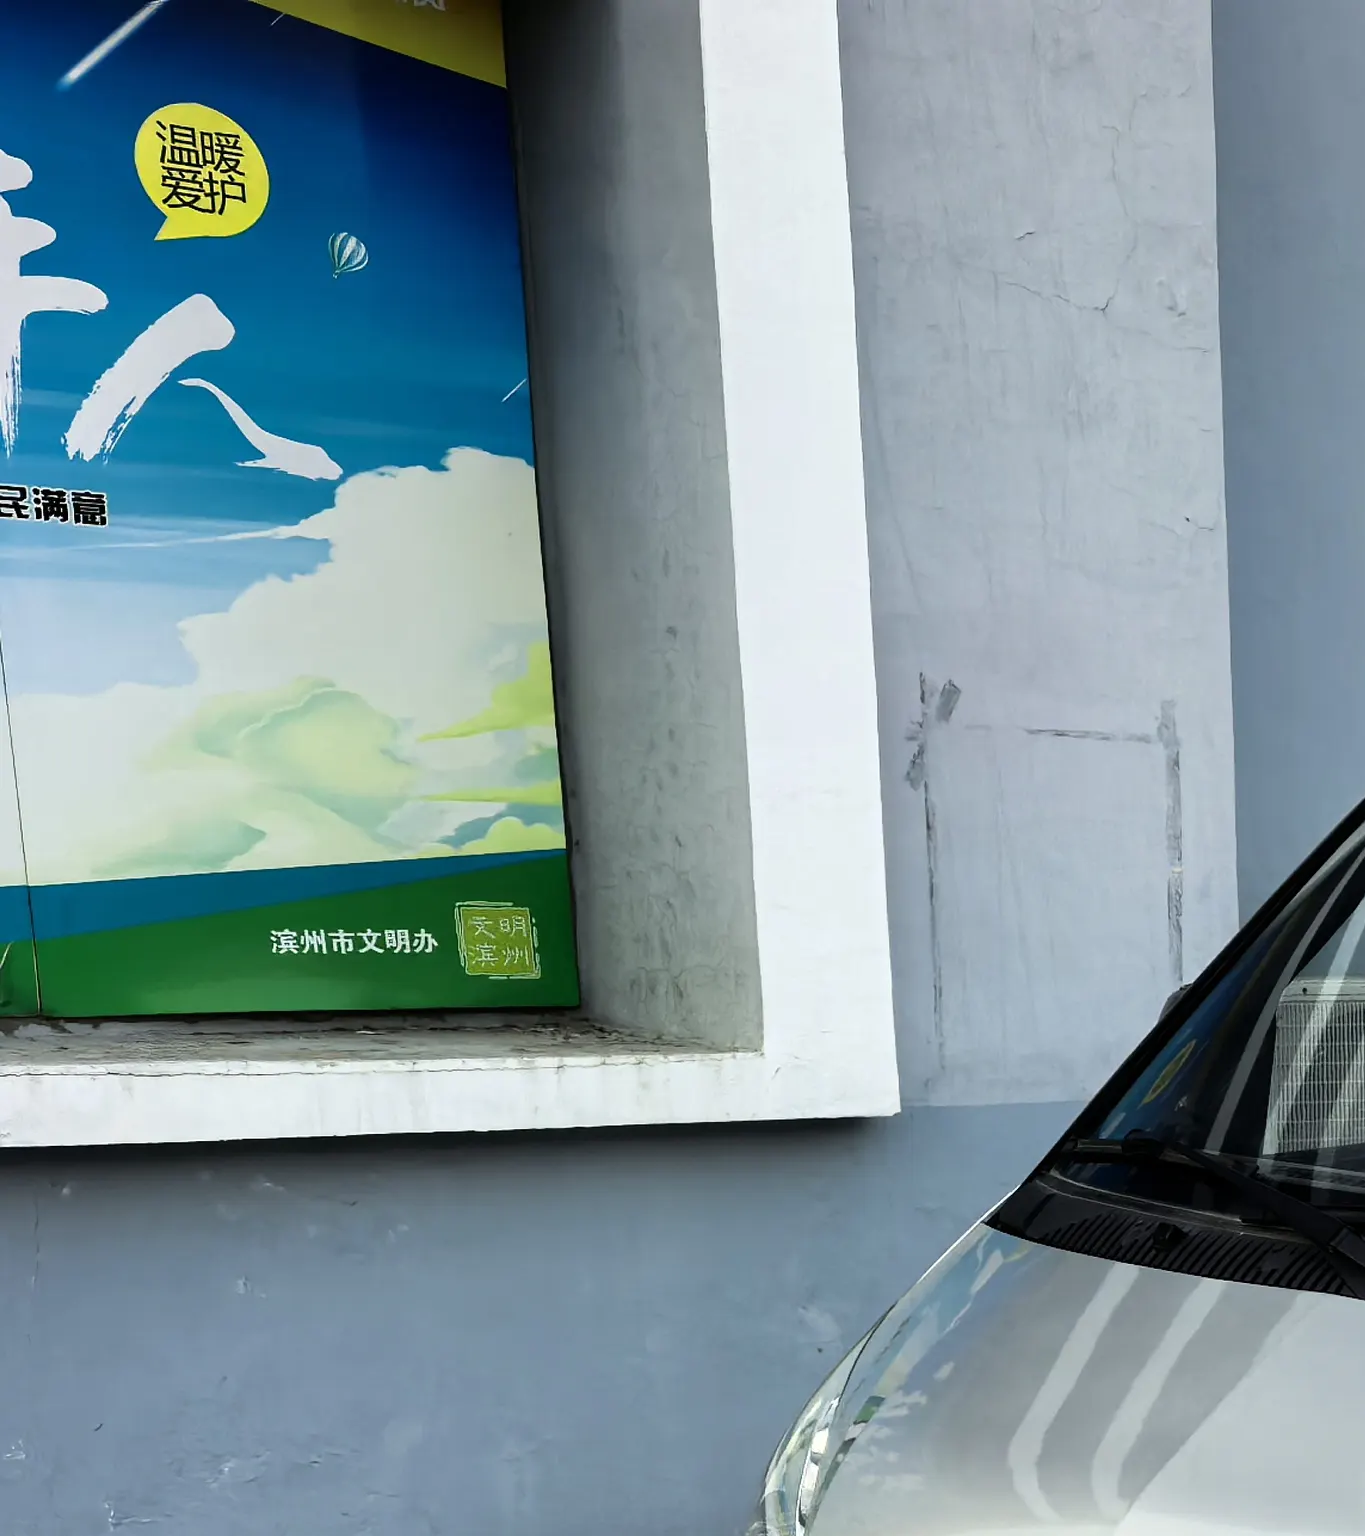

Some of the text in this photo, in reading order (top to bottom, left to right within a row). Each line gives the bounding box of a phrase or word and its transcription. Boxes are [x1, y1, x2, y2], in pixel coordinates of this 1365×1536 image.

[155, 120, 246, 177] 温暖
[160, 165, 248, 216] 爱护
[0, 485, 107, 526] 民满意
[270, 929, 438, 954] 滨州市文明办
[468, 915, 528, 939] 文明
[470, 943, 530, 967] 滨州
